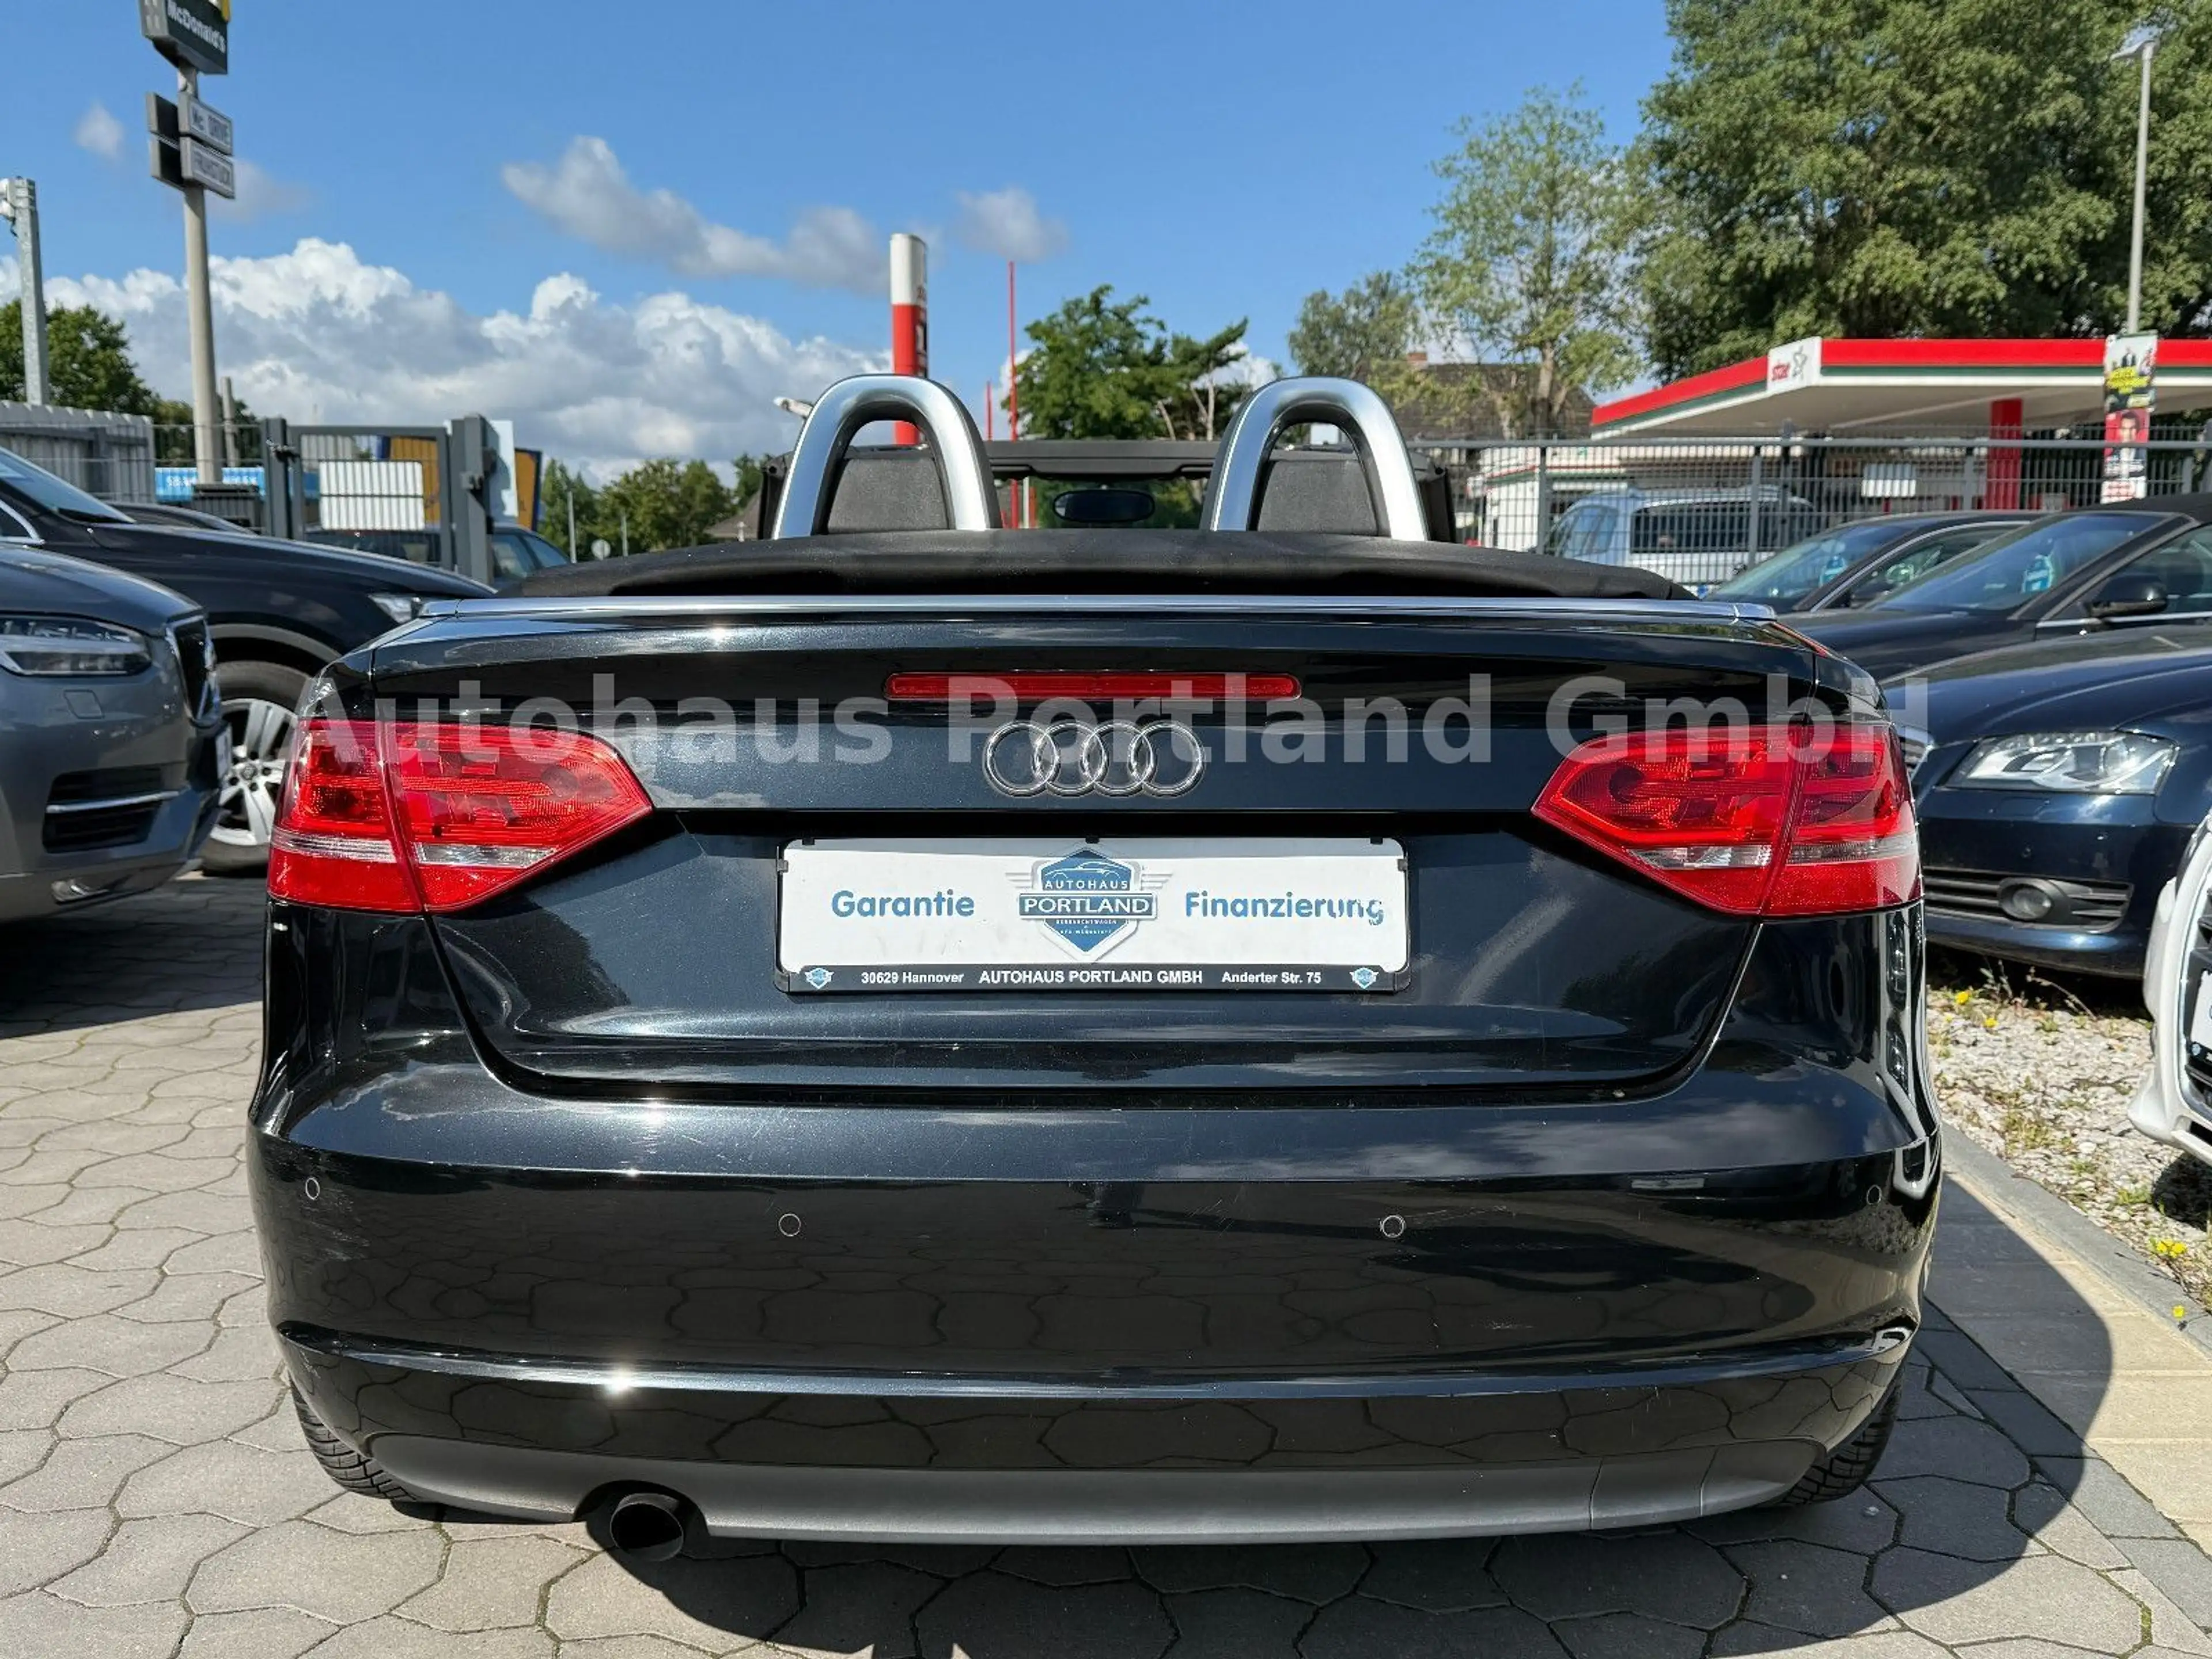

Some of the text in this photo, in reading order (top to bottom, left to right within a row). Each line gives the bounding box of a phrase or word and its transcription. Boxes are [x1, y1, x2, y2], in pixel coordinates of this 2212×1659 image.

[167, 0, 226, 54] McDonald's
[1044, 880, 1128, 889] AUTOHAUS
[832, 889, 975, 918] Garantie
[1024, 897, 1150, 914] PORTLAND
[1185, 890, 1384, 926] Finanzierung
[902, 972, 965, 983] Hannover
[979, 970, 1203, 984] AUTOHAUS PORTLAND GMBH
[1222, 971, 1321, 984] Anderter Str. 75
